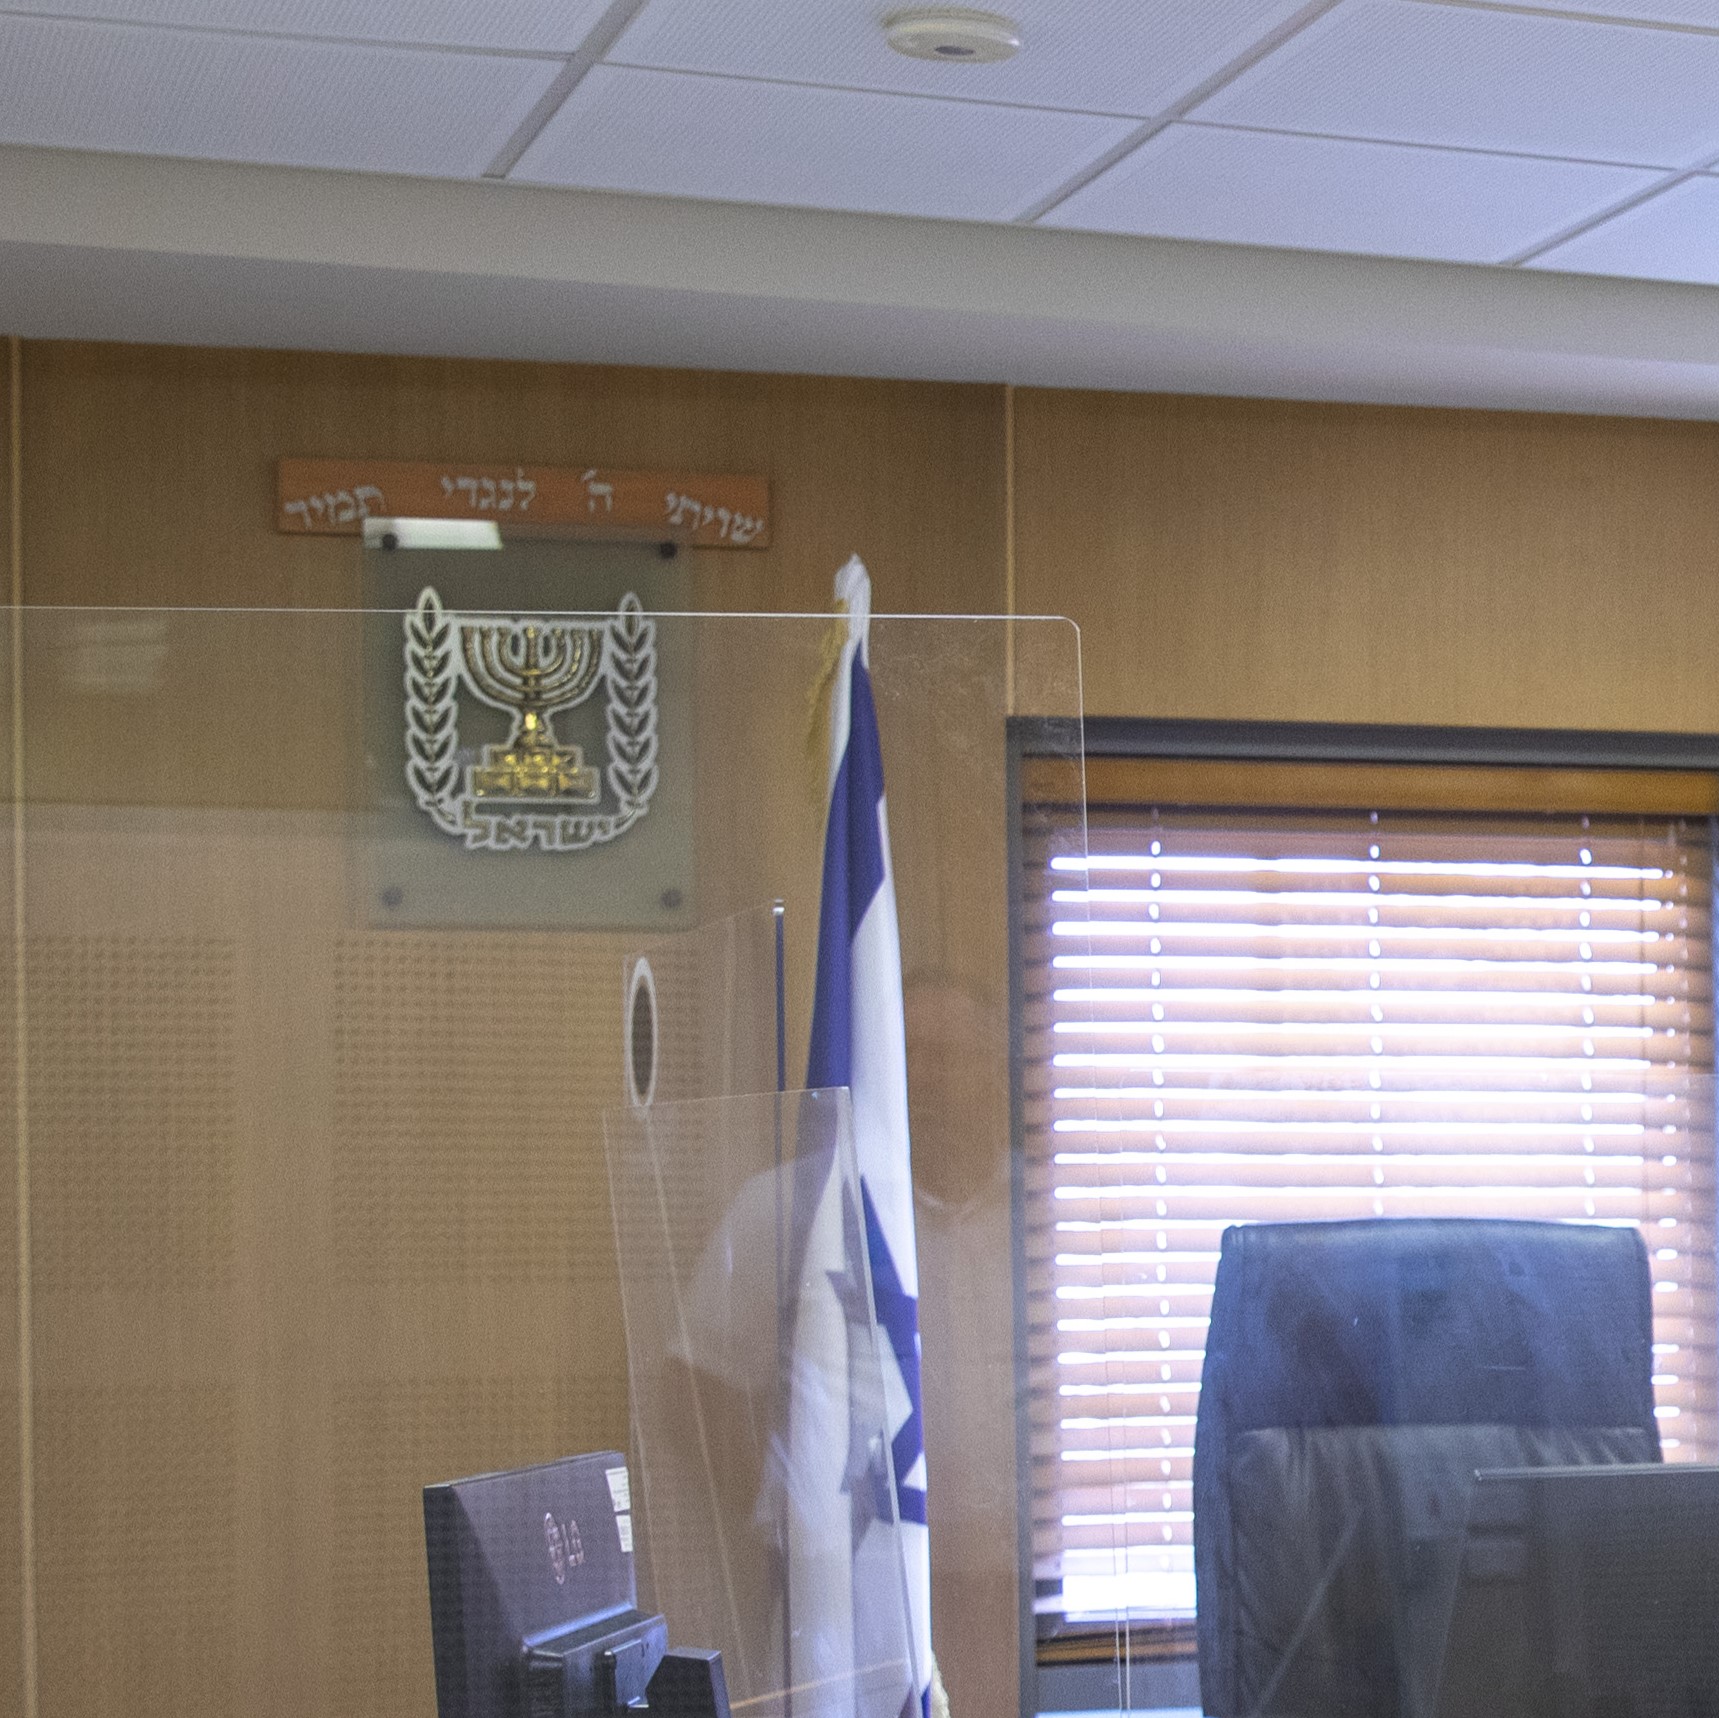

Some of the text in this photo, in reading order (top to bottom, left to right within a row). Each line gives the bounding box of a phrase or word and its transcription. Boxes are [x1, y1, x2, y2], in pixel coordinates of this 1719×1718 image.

[282, 485, 388, 530] תמיד
[440, 466, 537, 512] לנגדי
[664, 490, 765, 544] שויתי
[461, 798, 612, 847] ישראל
